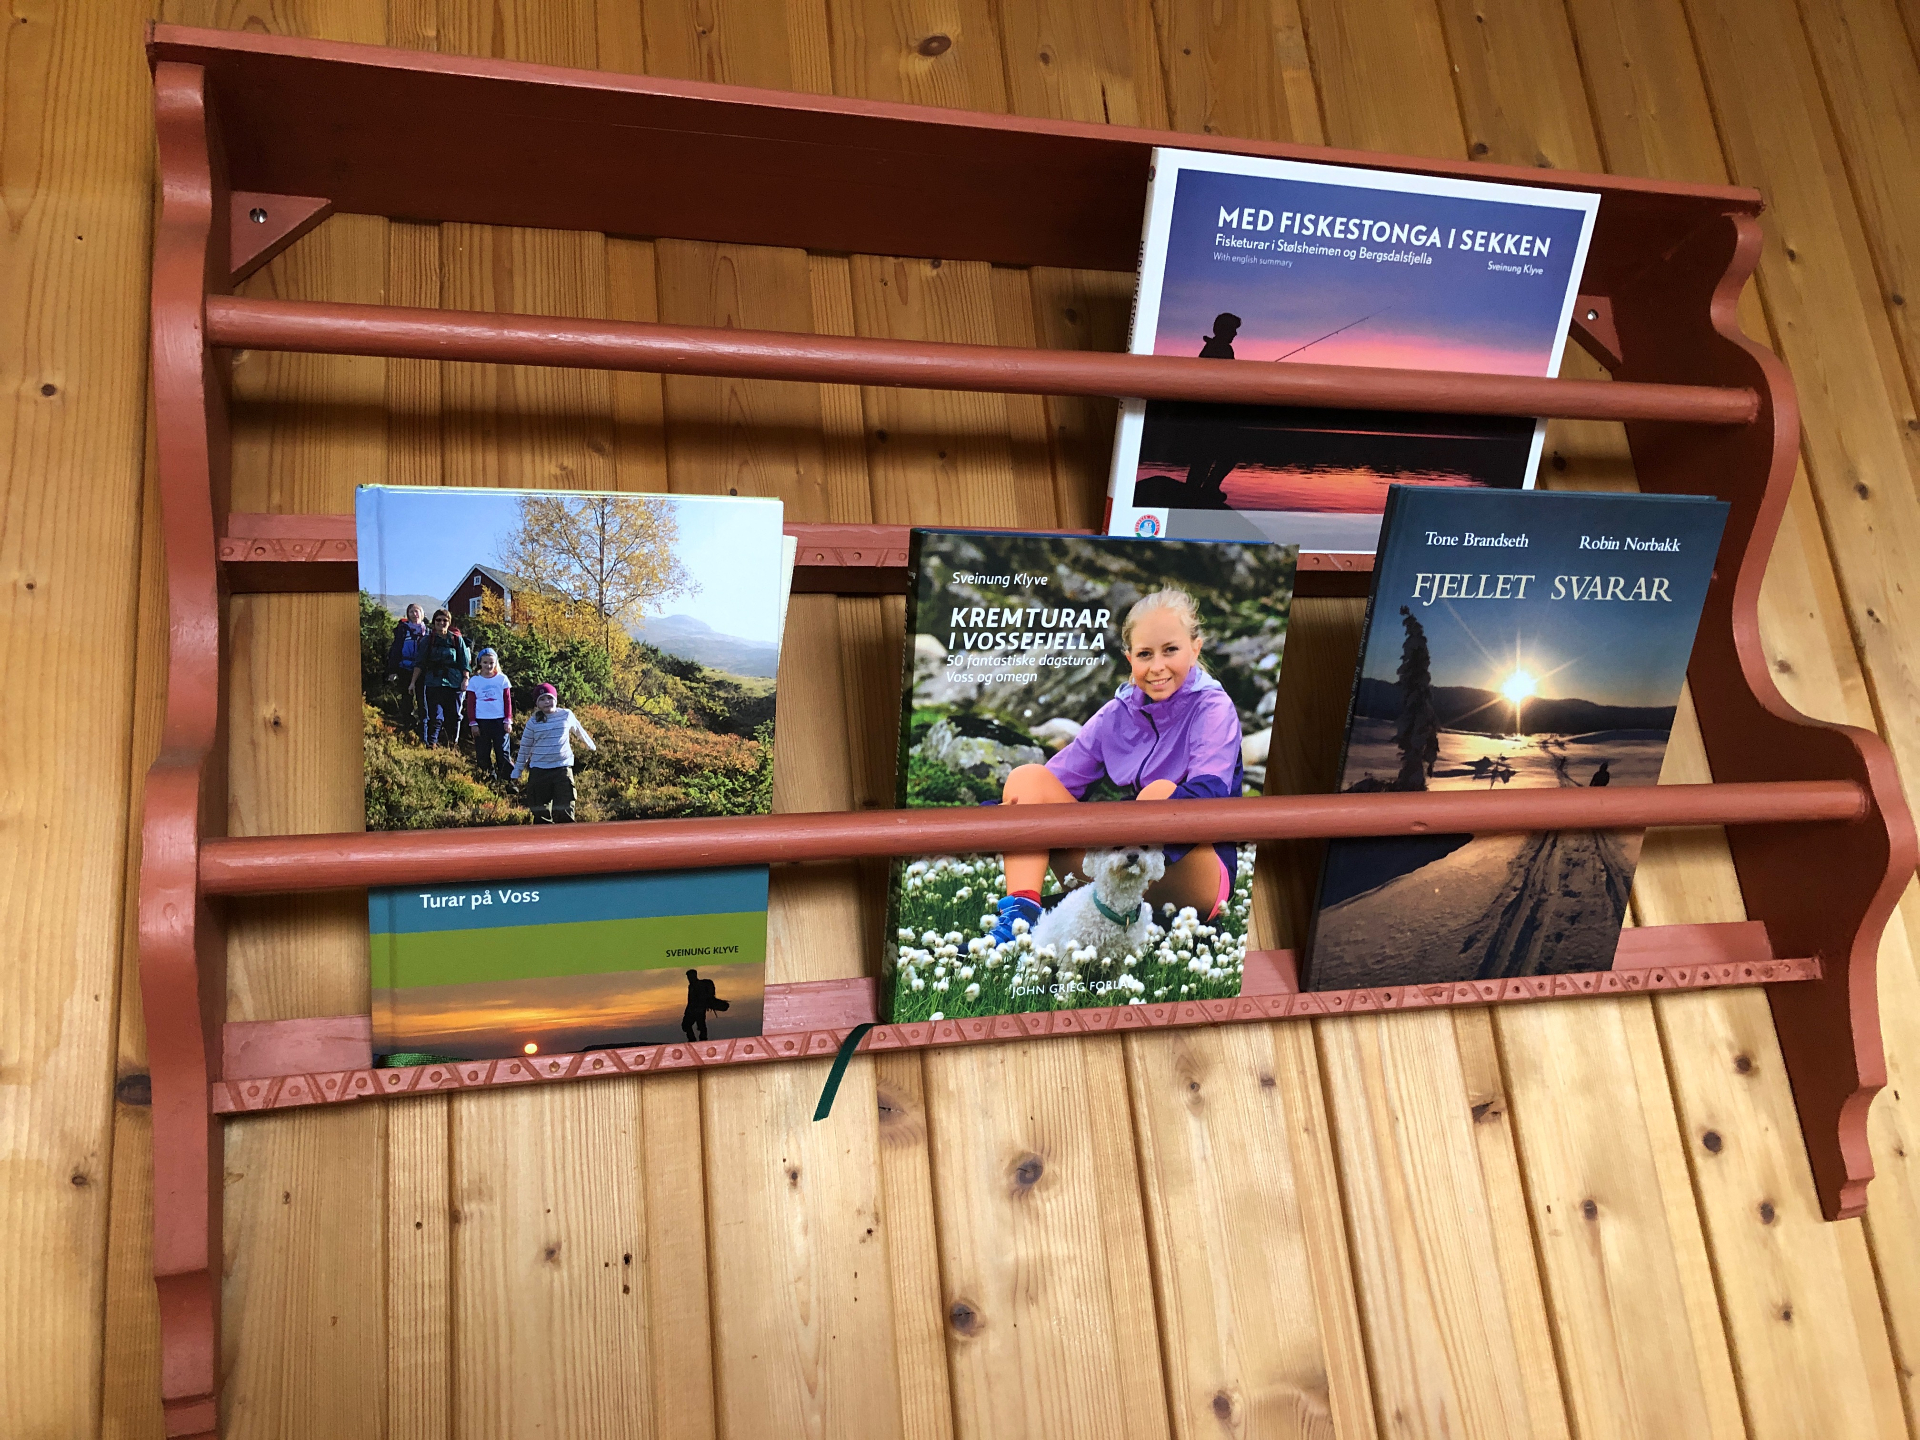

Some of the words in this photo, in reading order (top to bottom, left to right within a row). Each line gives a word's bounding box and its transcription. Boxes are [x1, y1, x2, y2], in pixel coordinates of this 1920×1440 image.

[1217, 205, 1274, 231] MED
[1279, 211, 1442, 248] FISKESTONGA
[1447, 228, 1457, 249] I
[1459, 229, 1552, 258] SEKKEN
[1215, 233, 1271, 250] Fisketurar
[1271, 239, 1276, 251] i
[1276, 239, 1341, 257] Stølsheimen
[1343, 249, 1357, 260] og
[1358, 247, 1433, 265] Bergsdalsfjella
[1213, 251, 1231, 262] With
[1231, 253, 1258, 265] english
[1259, 258, 1293, 268] summary
[1487, 260, 1522, 275] Sveinung
[1523, 264, 1544, 276] Klyve
[1425, 531, 1458, 546] Tone
[1462, 532, 1529, 548] Brandseth
[1579, 536, 1620, 550] Robin
[1623, 537, 1681, 552] Norbakk
[952, 572, 1011, 588] Sveinung
[1013, 572, 1048, 588] Klyve
[1411, 573, 1535, 607] FJELLET
[1550, 575, 1672, 602] SVARAR
[950, 607, 1111, 629] KREMTURAR
[948, 632, 956, 650] I
[962, 632, 1105, 650] VOSSEFJELLA
[946, 654, 964, 667] 50
[967, 653, 1035, 668] fantastiske
[1038, 654, 1100, 668] dagsturar
[1101, 654, 1105, 665] i
[946, 671, 974, 683] Voss
[977, 673, 992, 685] og
[995, 673, 1037, 685] omegn
[419, 893, 466, 908] Turar
[471, 889, 493, 910] på
[498, 889, 540, 904] Voss
[666, 947, 711, 958] SVEINUNG
[713, 945, 739, 955] KLYVE
[1011, 984, 1045, 999] JOHN
[1049, 982, 1085, 993] GRIEG
